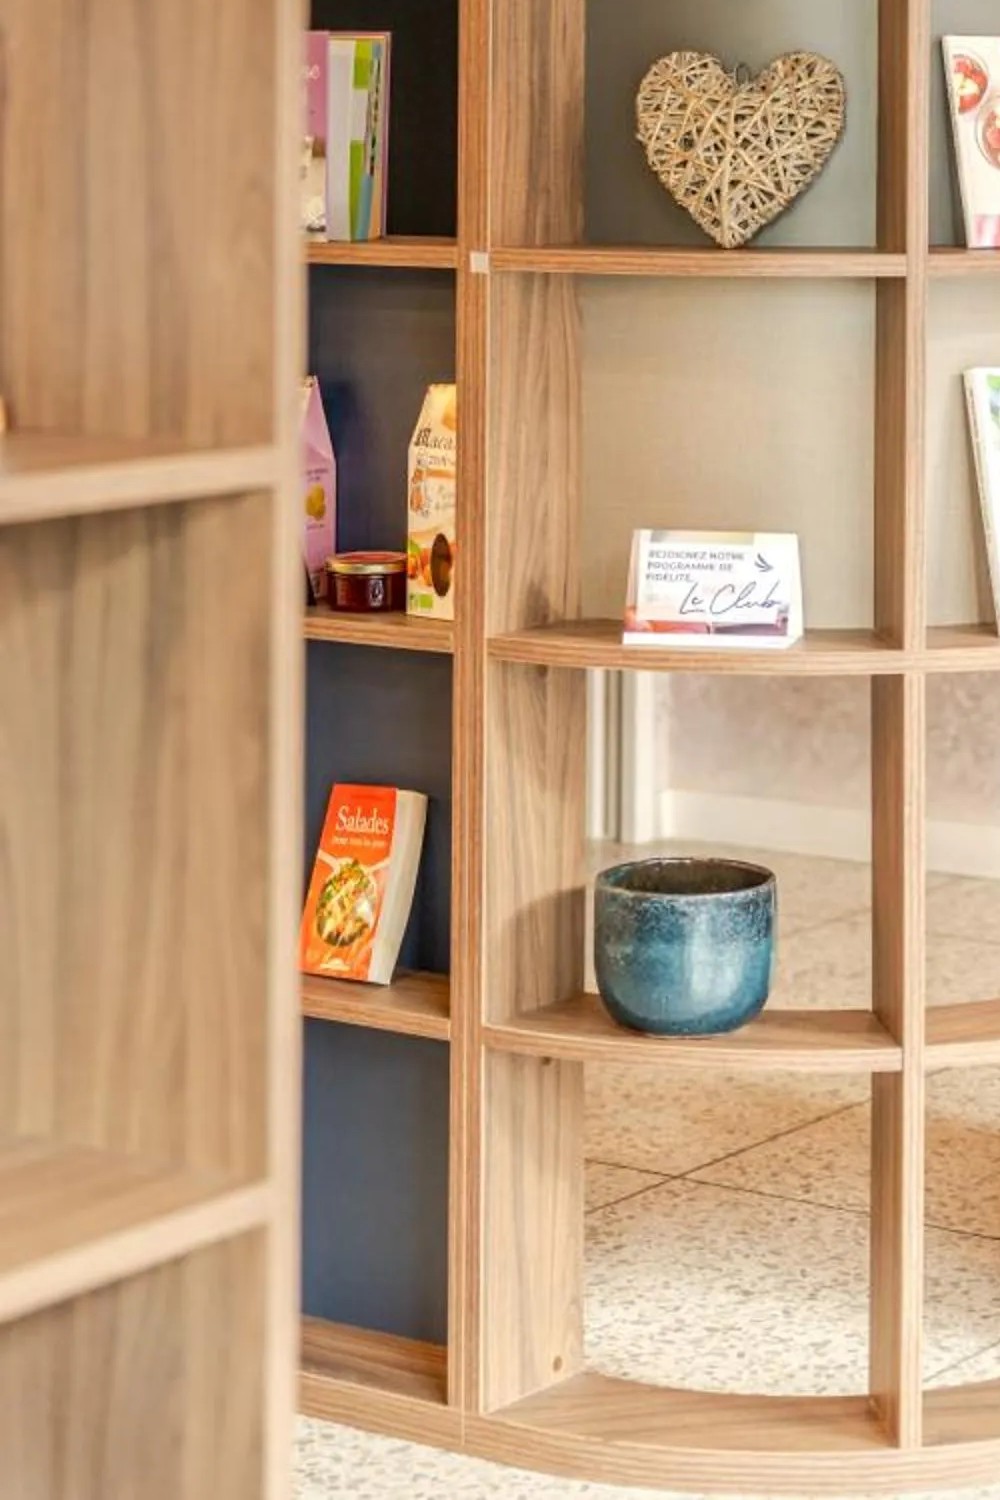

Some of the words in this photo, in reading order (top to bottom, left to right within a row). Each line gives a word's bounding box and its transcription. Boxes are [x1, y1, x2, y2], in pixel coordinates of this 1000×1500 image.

[679, 581, 706, 615] Le
[709, 578, 783, 615] Club
[336, 804, 390, 835] Salades
